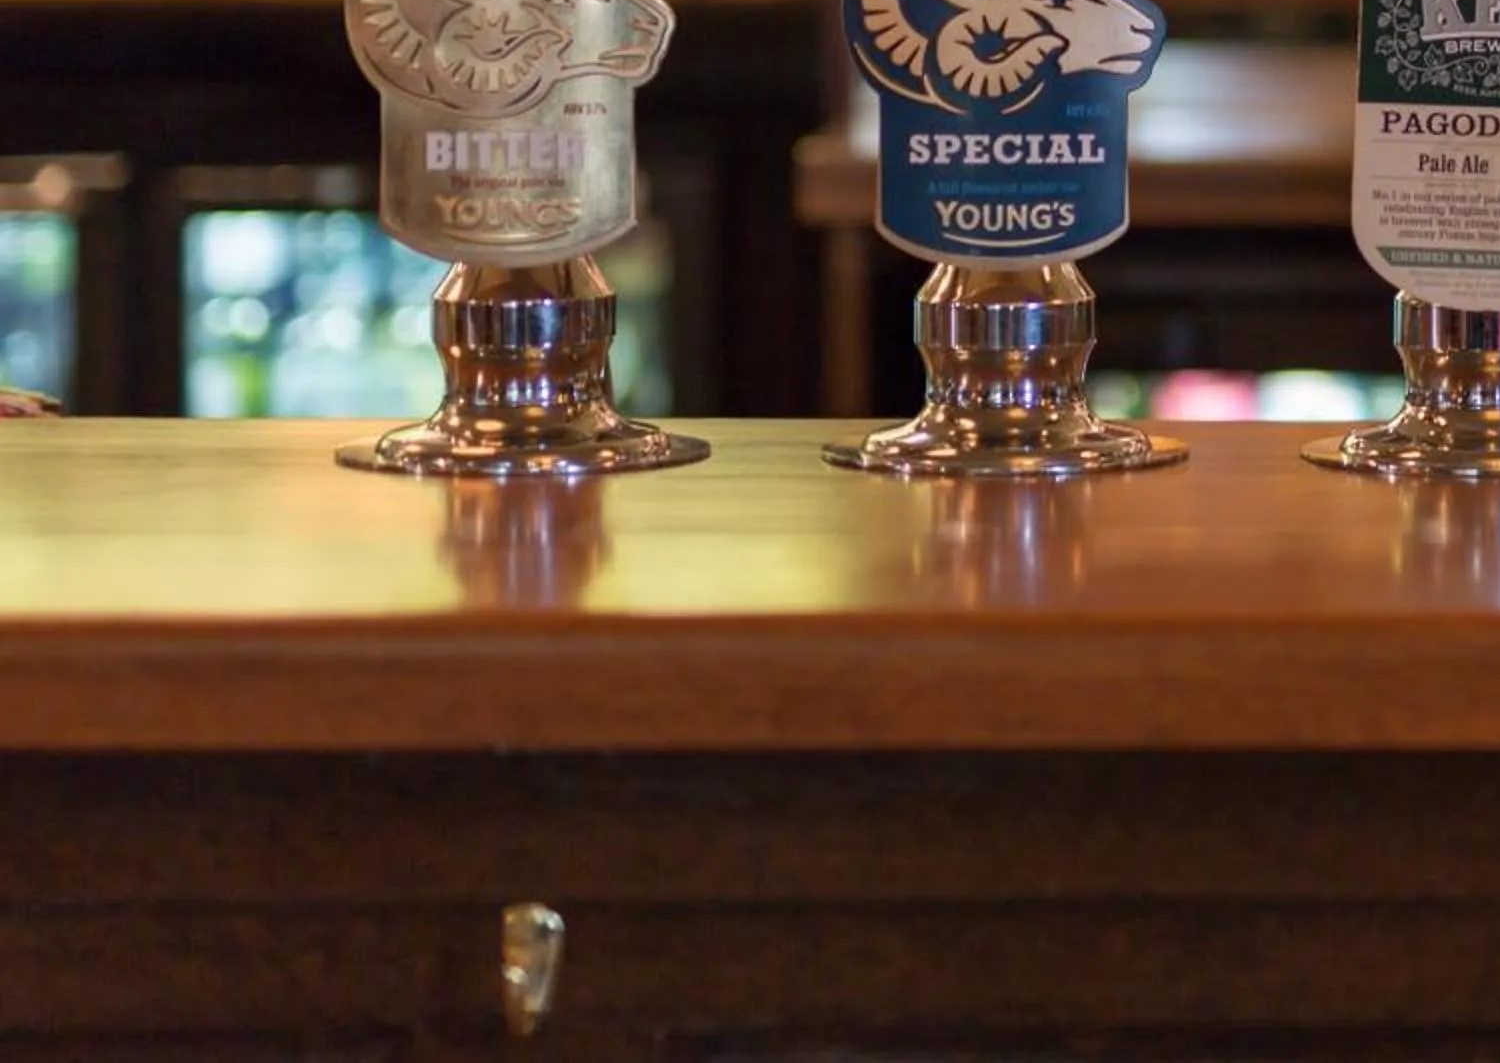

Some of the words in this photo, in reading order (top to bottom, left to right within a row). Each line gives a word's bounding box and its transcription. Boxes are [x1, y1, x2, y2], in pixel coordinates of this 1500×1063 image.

[425, 131, 587, 171] BITTER
[908, 133, 1106, 165] SPECIAL
[1417, 153, 1457, 174] Pale
[1461, 154, 1490, 175] Ale
[935, 200, 1076, 231] YOUNG'S
